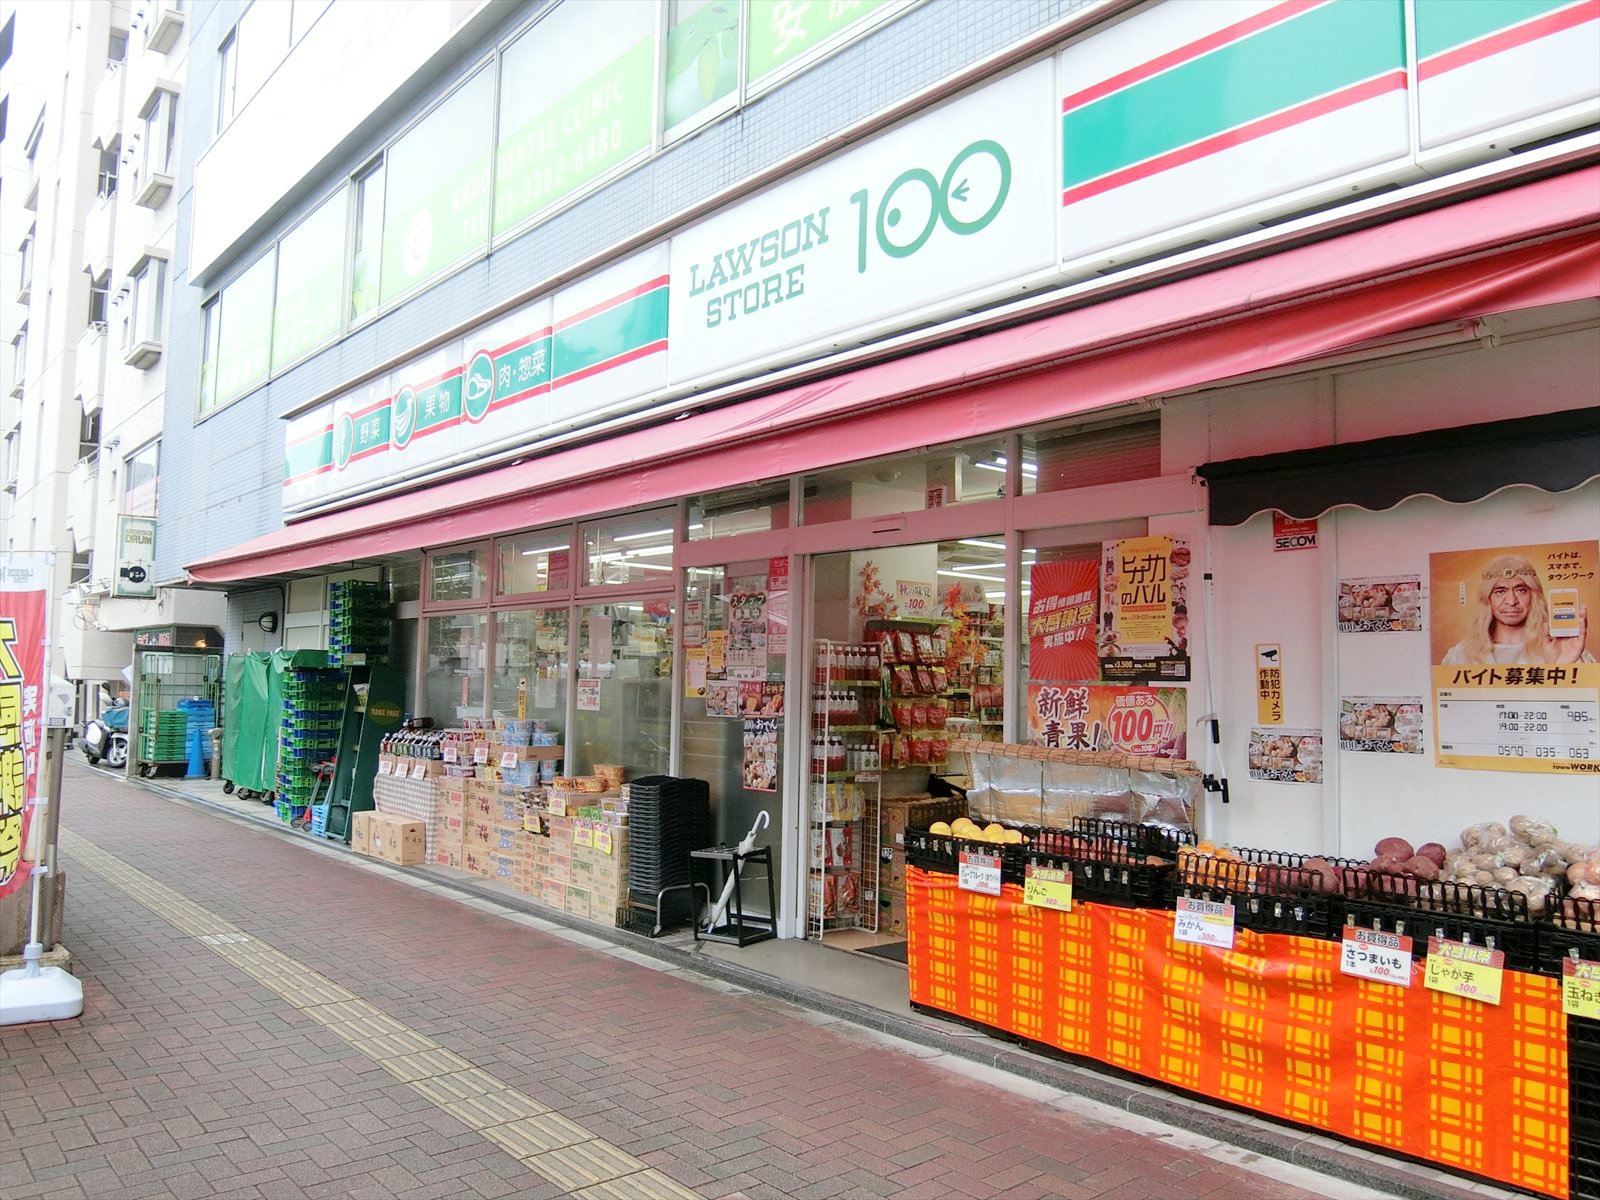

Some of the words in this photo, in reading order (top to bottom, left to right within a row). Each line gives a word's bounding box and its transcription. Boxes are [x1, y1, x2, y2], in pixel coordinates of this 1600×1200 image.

[498, 120, 556, 180] DENTAL
[564, 75, 624, 134] CLINIC
[850, 139, 1012, 275] 100
[464, 206, 486, 243] TEL
[689, 206, 830, 297] LAWSON
[706, 264, 806, 329] STORE
[425, 391, 451, 420] 果物
[360, 416, 381, 444] 野菜
[126, 535, 152, 545] DRUM
[1275, 534, 1316, 549] SECOM
[1547, 572, 1594, 581] タウンワーク
[908, 598, 924, 609] 100
[1121, 584, 1167, 605] のバル
[1030, 602, 1095, 636] 大感謝祭
[1359, 617, 1392, 632] おでん
[1259, 667, 1270, 700] 作動中
[1038, 688, 1088, 718] 新鮮
[1269, 667, 1281, 722] 防犯カメラ
[386, 709, 400, 718] FREE
[1360, 738, 1393, 752] おでん
[1178, 919, 1204, 931] みかん
[1356, 930, 1399, 947] お買得品
[1345, 960, 1356, 968] 1本
[1346, 948, 1402, 969] さつまいも
[1373, 965, 1390, 976] 100
[1430, 963, 1475, 983] じゃが芋
[1458, 982, 1477, 994] 100
